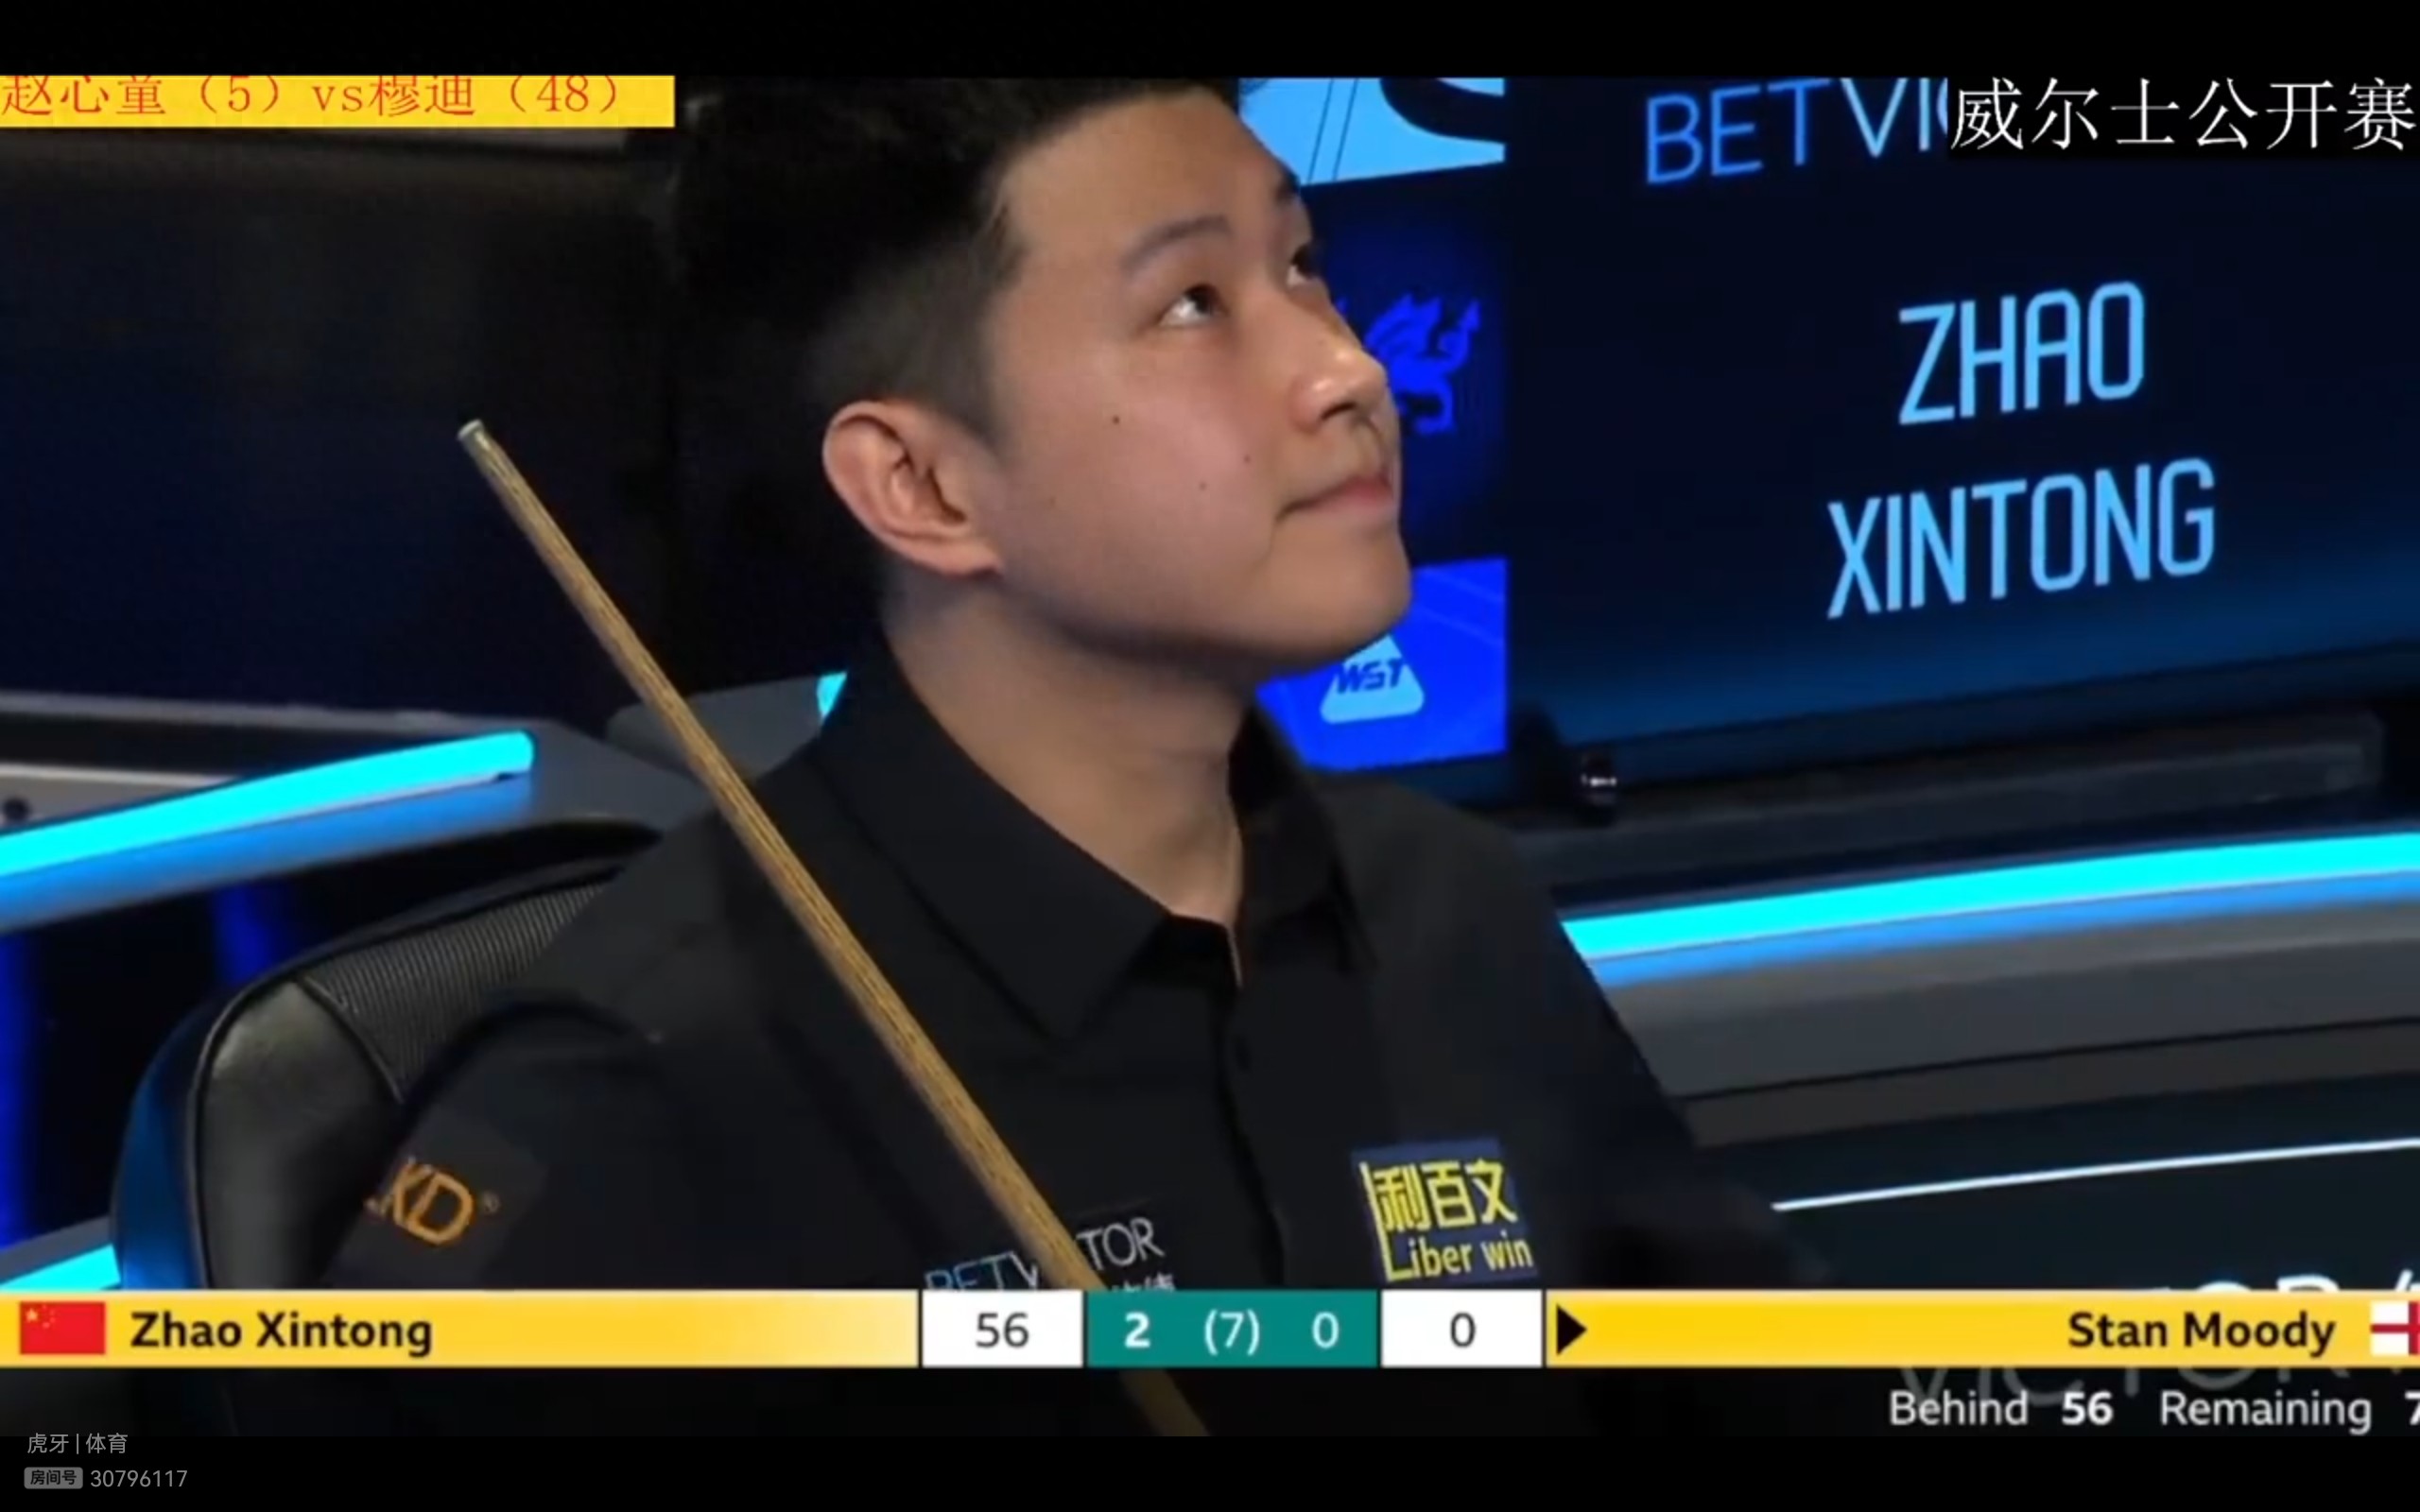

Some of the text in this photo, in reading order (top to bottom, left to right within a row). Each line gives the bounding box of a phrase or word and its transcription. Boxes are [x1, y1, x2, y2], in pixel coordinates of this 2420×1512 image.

[1646, 77, 1948, 185] BETVI
[1898, 281, 2146, 426] ZHAO
[1826, 457, 2217, 621] XINTONG
[1336, 657, 1405, 695] WST
[1372, 1157, 1519, 1233] 利百文
[1479, 1228, 1535, 1272] win
